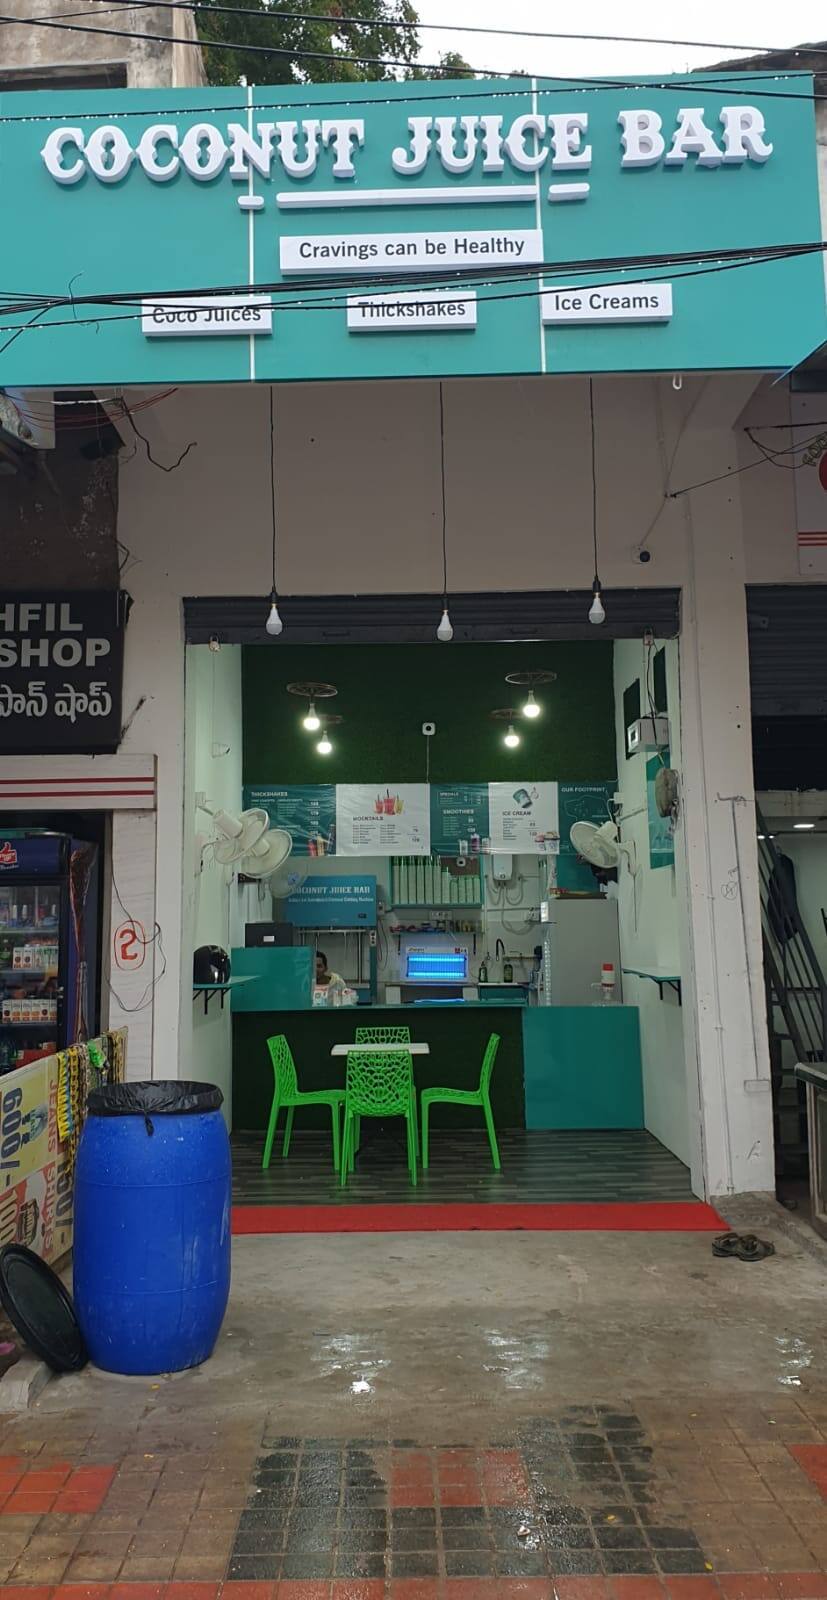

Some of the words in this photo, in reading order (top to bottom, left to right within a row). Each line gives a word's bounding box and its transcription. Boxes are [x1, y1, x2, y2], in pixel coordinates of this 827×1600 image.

[41, 119, 365, 185] COCONUT
[392, 112, 592, 175] JUICE
[617, 105, 774, 168] BAR
[299, 241, 378, 260] Cravings
[384, 241, 417, 256] can
[425, 237, 447, 256] be
[454, 236, 525, 256] Healthy
[358, 299, 466, 318] Thickshakes
[554, 294, 583, 311] Ice
[588, 292, 659, 311] Creams
[152, 307, 198, 324] Coco
[204, 304, 262, 323] Juices
[0, 638, 111, 668] SHOP
